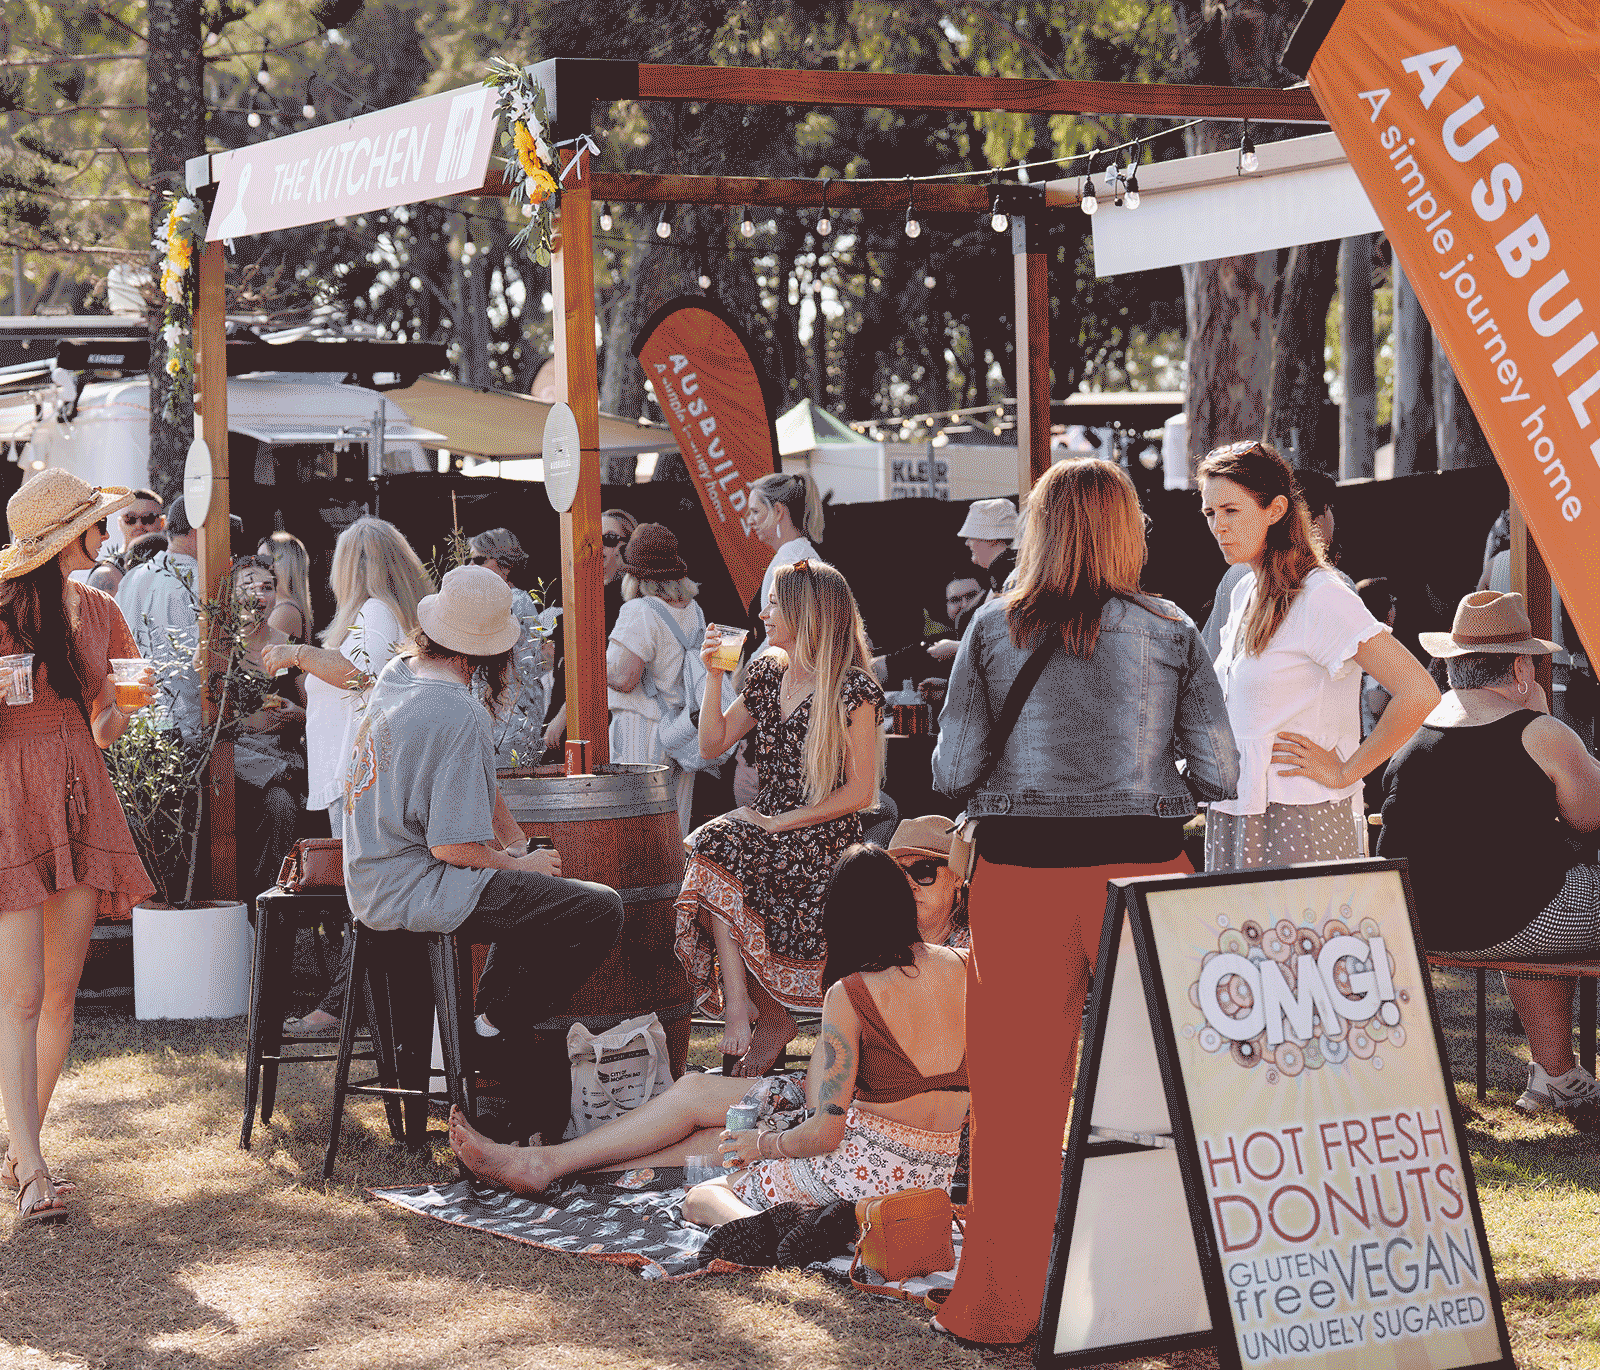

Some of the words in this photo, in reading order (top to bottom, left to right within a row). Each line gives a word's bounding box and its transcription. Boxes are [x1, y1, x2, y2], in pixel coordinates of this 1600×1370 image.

[271, 158, 310, 205] THE
[307, 122, 432, 204] KITCHEN
[1401, 45, 1600, 469] AUSBUIL
[1357, 88, 1391, 124] A
[1380, 125, 1454, 255] simple
[1439, 253, 1530, 404] journey
[1520, 404, 1582, 522] home
[1198, 935, 1401, 1047] OMG!
[1203, 1127, 1303, 1188] HOT
[1319, 1109, 1449, 1171] FRESH
[1212, 1163, 1465, 1253] DONUTS
[1228, 1250, 1330, 1288] GLUTEN
[1328, 1228, 1479, 1301] VEGAN
[1234, 1279, 1337, 1322] free
[1243, 1313, 1365, 1361] UNIQUELY
[1372, 1295, 1486, 1339] SUGARED
